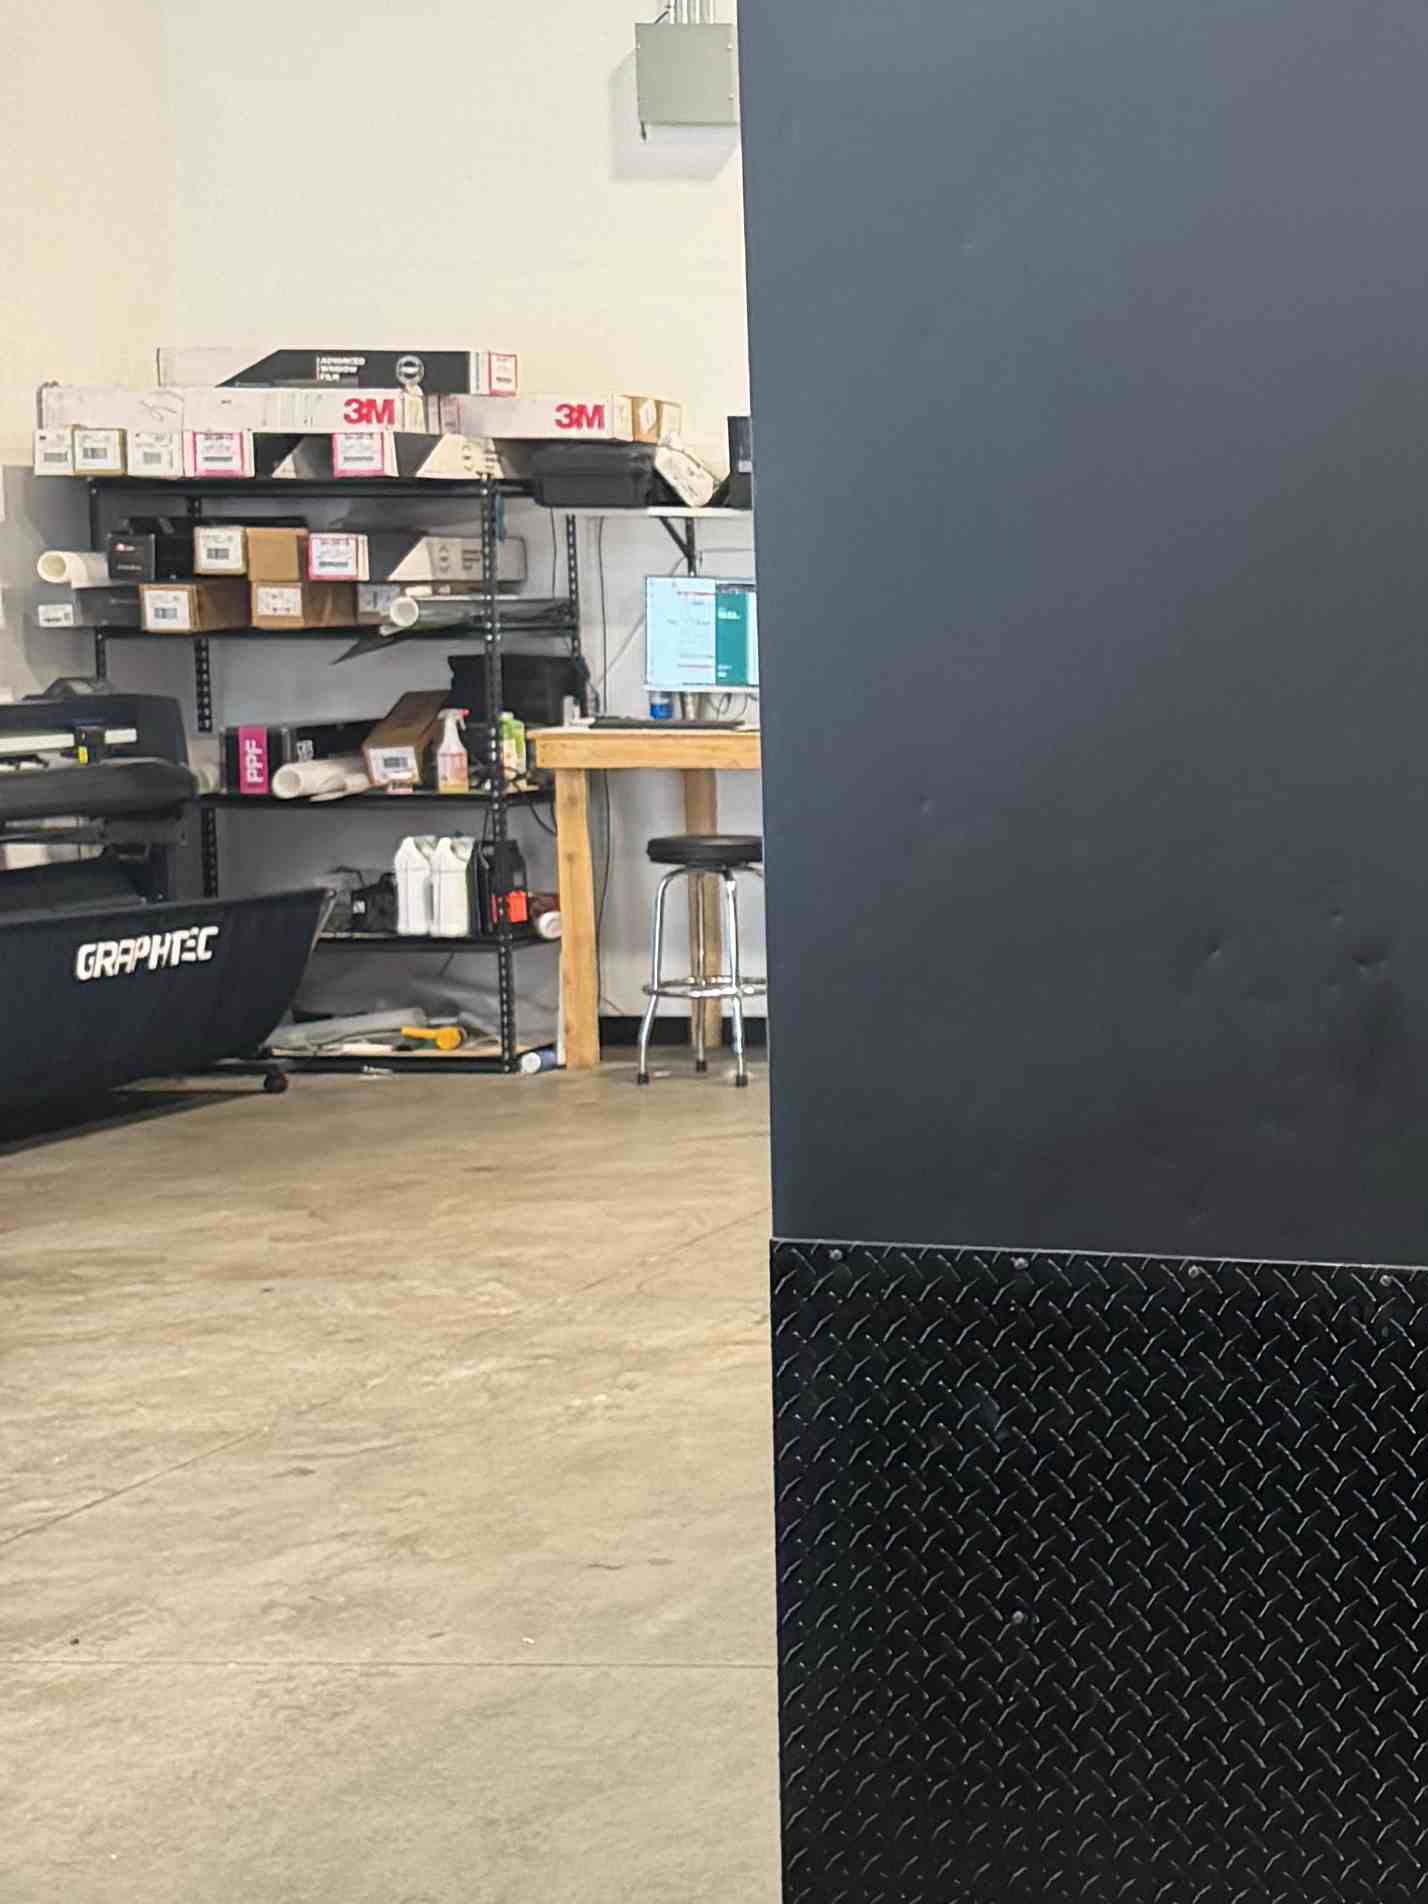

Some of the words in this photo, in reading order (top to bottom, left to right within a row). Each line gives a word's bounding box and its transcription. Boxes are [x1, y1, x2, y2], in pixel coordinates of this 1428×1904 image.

[343, 398, 395, 425] 3M
[555, 403, 605, 430] 3M
[244, 739, 264, 784] PPF
[76, 926, 219, 981] GRAPHTEC
